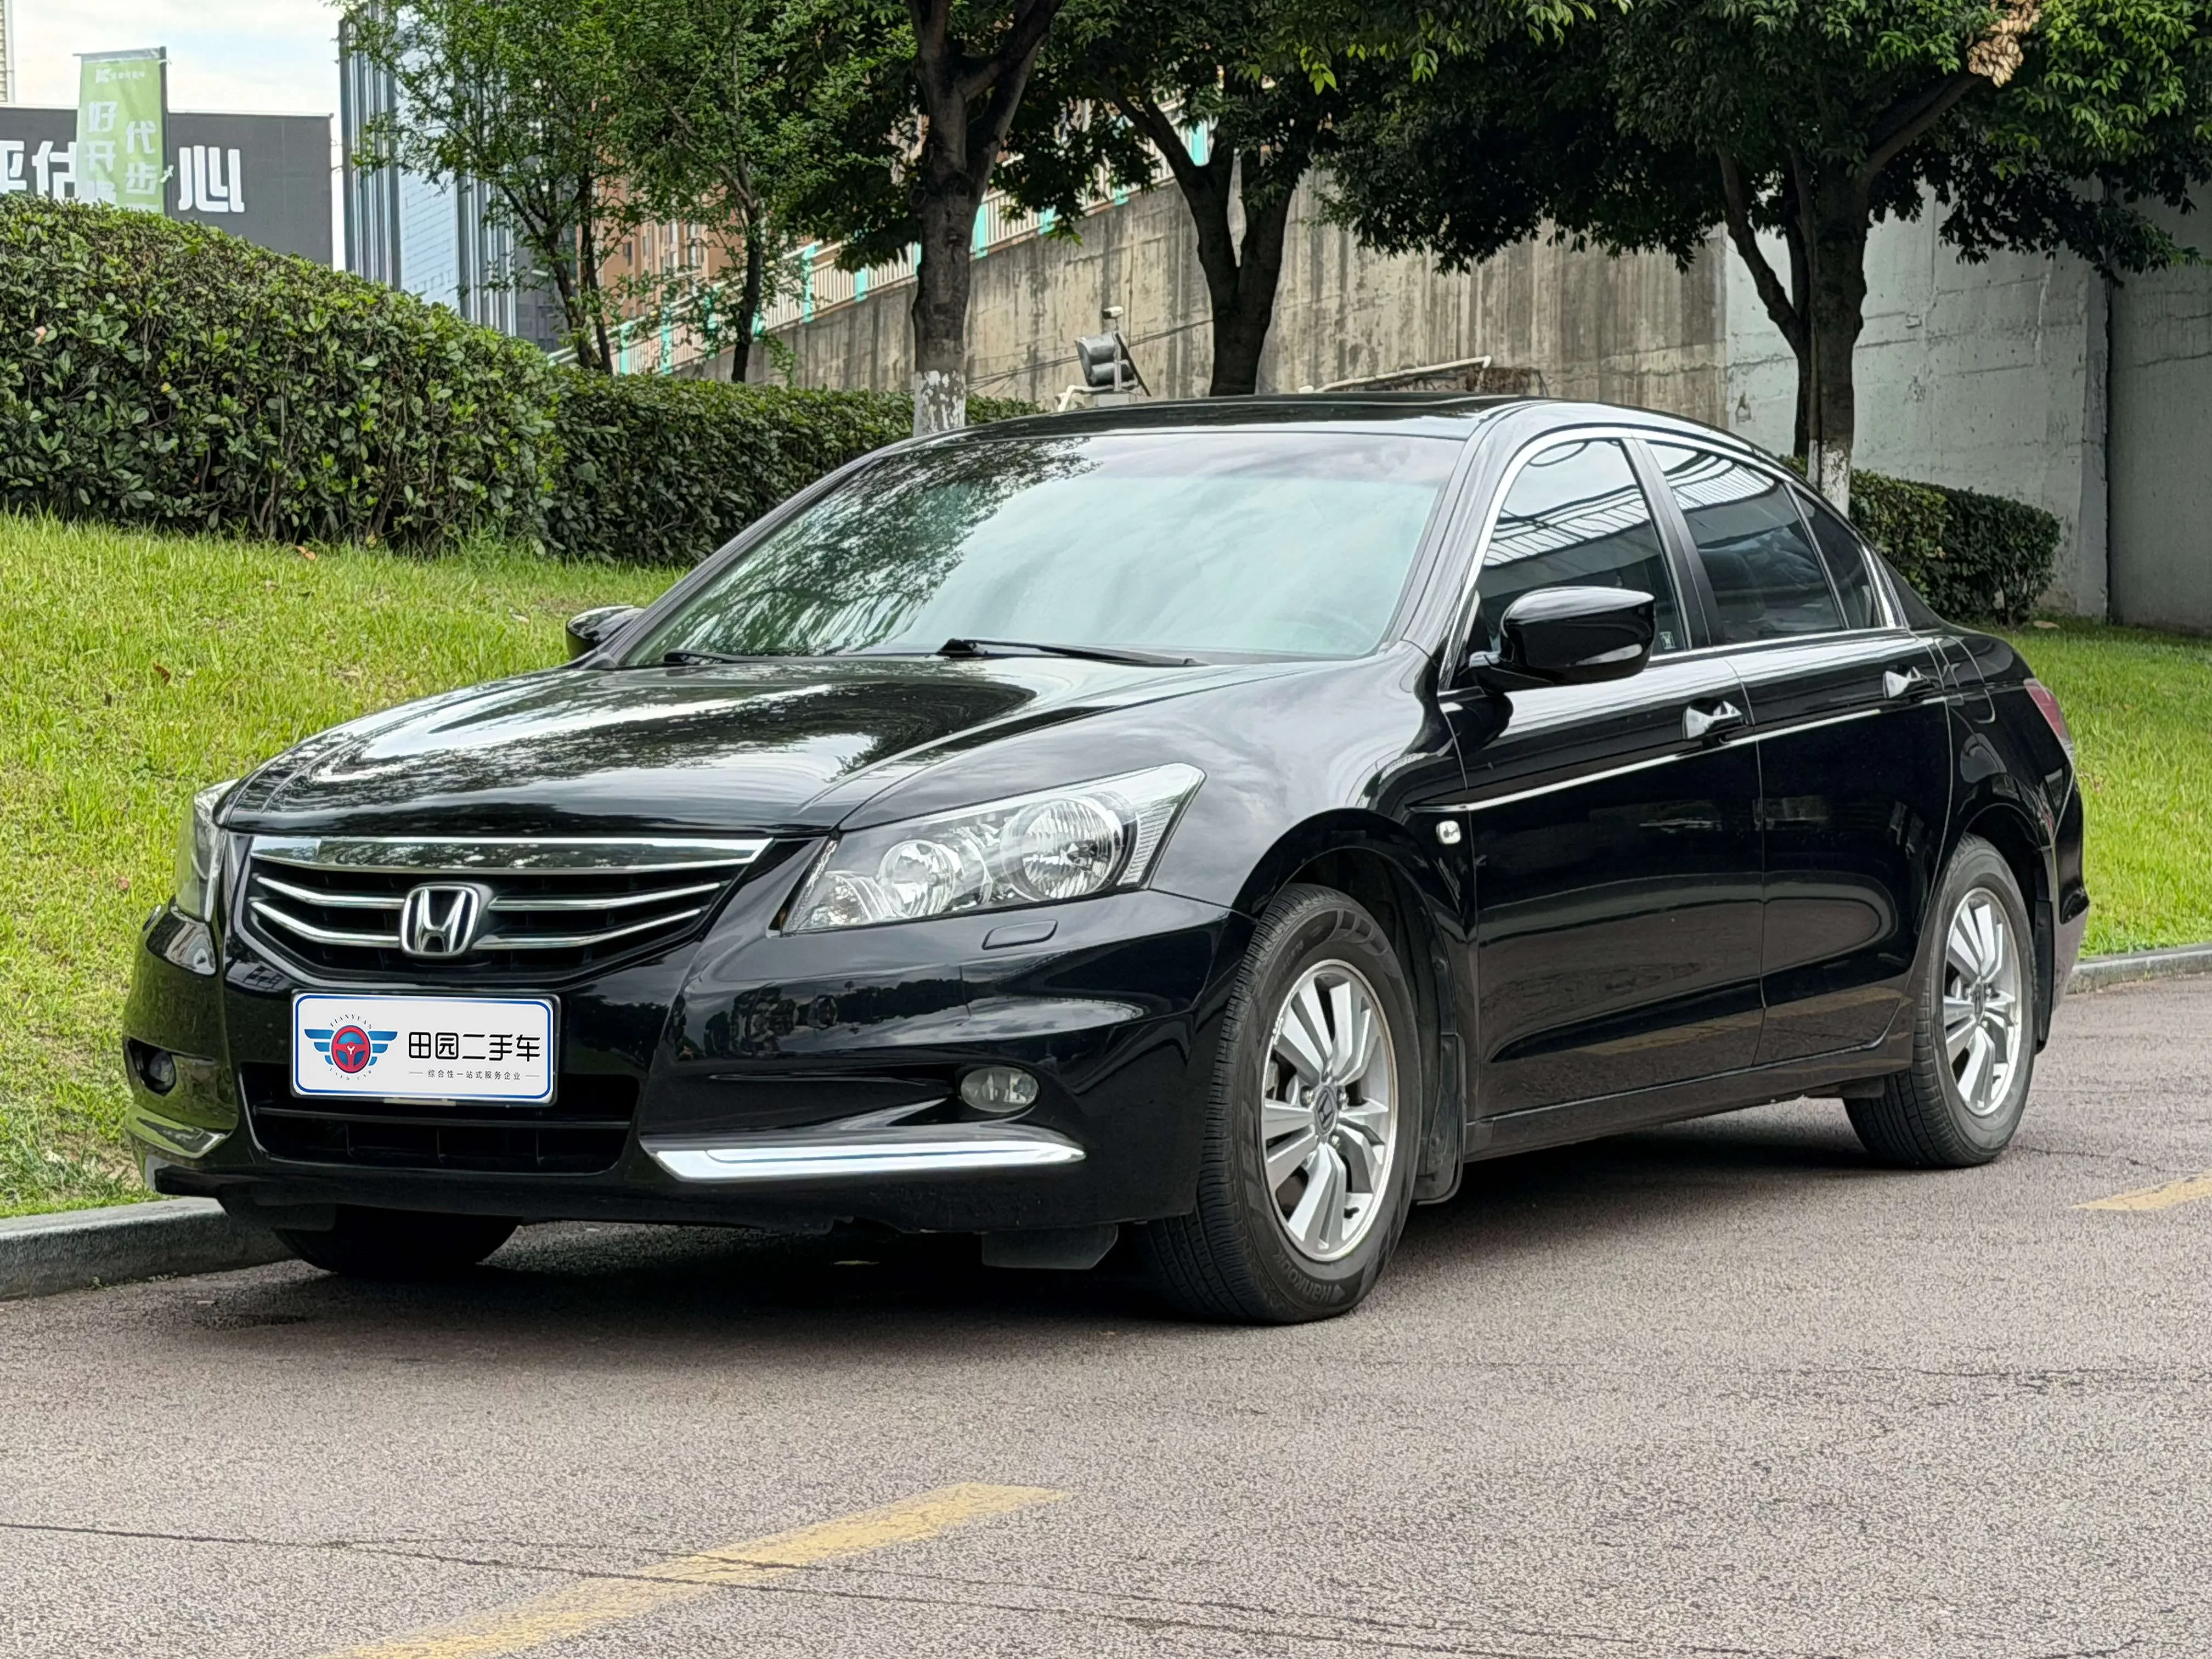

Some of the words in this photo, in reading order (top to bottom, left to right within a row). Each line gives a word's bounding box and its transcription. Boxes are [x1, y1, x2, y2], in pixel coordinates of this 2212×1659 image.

[409, 1032, 540, 1062] 田园二手车
[428, 1069, 520, 1080] 综合性一站式服务企业
